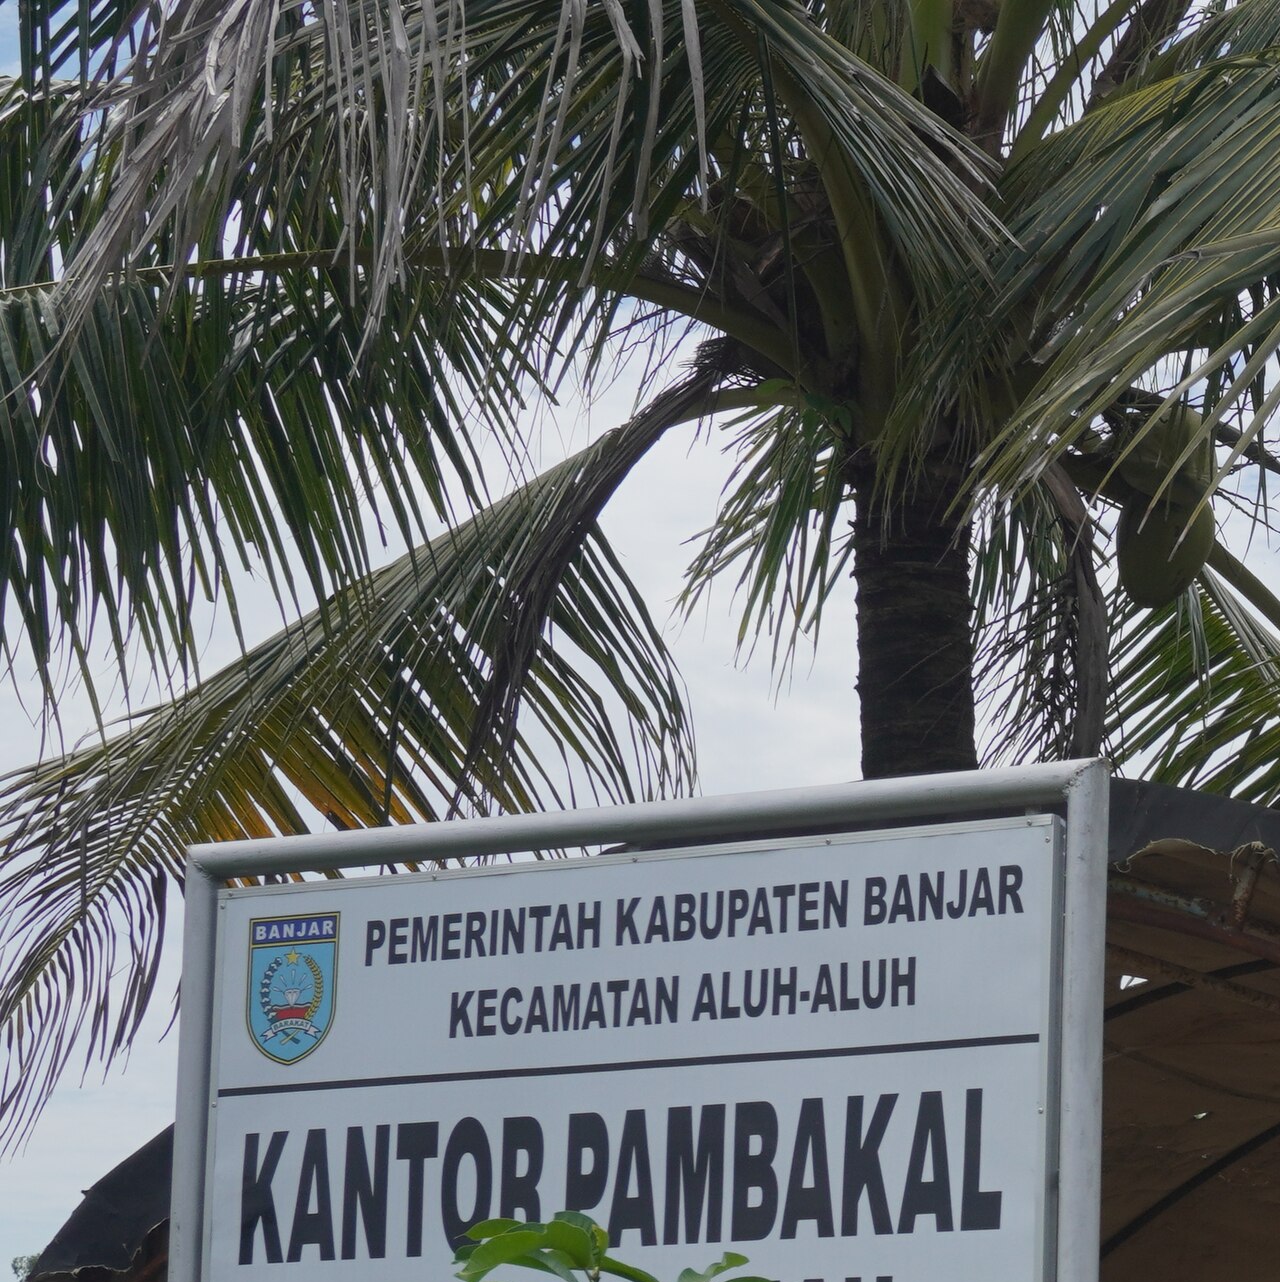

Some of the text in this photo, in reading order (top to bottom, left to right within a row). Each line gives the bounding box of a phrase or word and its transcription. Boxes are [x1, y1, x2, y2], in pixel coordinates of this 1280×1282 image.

[255, 920, 334, 941] BANJAR
[365, 865, 1024, 967] PEMERINTAH KABUPATEN BANJAR
[273, 1019, 310, 1031] BARAKAT
[449, 956, 917, 1040] KECAMATAN ALUH-ALUH
[238, 1088, 1002, 1266] KANTOR PAMBAKAL
